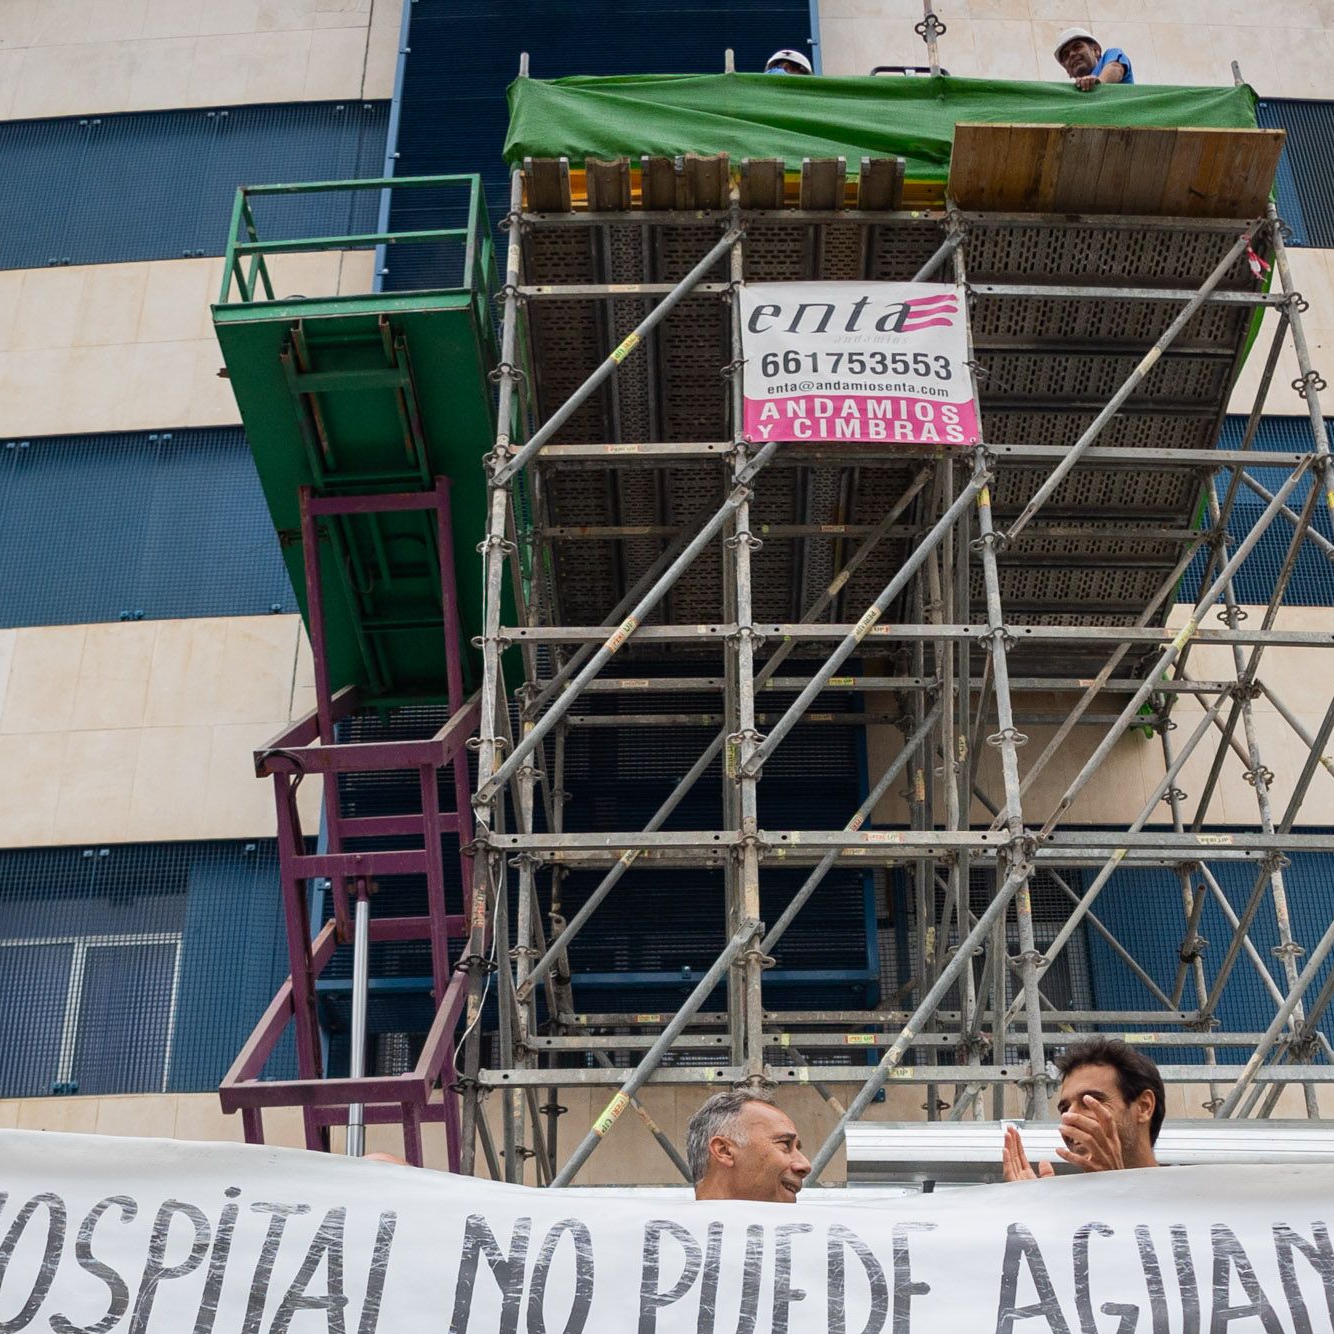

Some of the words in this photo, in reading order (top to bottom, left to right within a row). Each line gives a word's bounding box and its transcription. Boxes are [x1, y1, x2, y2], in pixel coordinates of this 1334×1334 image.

[748, 296, 912, 334] enta
[834, 335, 908, 345] andamios
[761, 350, 953, 381] 661753553
[767, 380, 950, 398] enta@andamiosenta.com
[760, 398, 960, 425] ANDAMIOS
[758, 424, 774, 440] Y
[793, 418, 965, 443] CIMBRAS
[611, 1100, 625, 1118] PERI
[601, 1118, 613, 1134] UP
